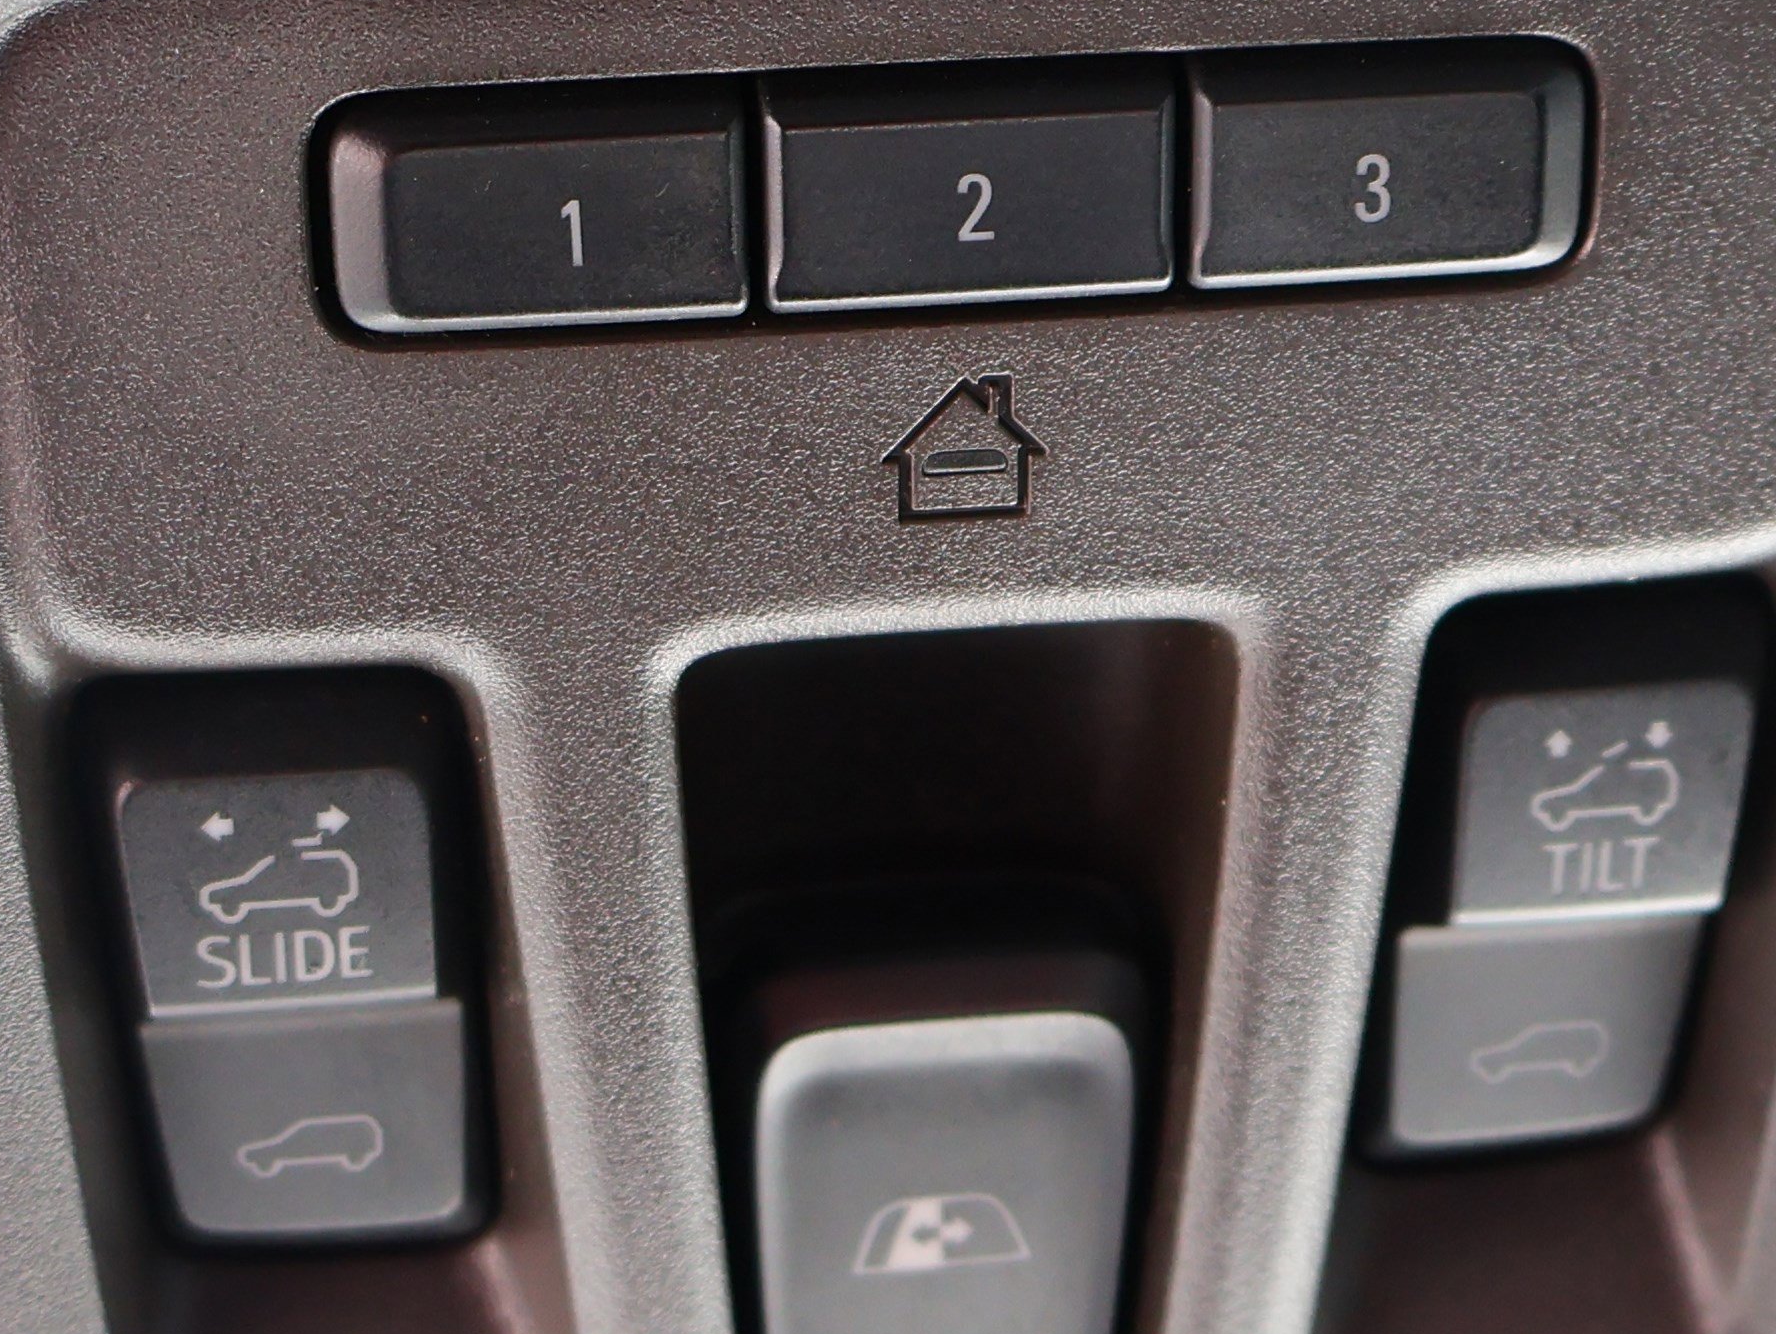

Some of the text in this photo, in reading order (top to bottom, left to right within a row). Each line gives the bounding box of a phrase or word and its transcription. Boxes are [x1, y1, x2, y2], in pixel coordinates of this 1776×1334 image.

[956, 172, 997, 242] 2
[1355, 154, 1393, 223] 3
[560, 199, 586, 267] 1
[1543, 836, 1661, 894] TILT
[196, 925, 373, 990] SLIDE
